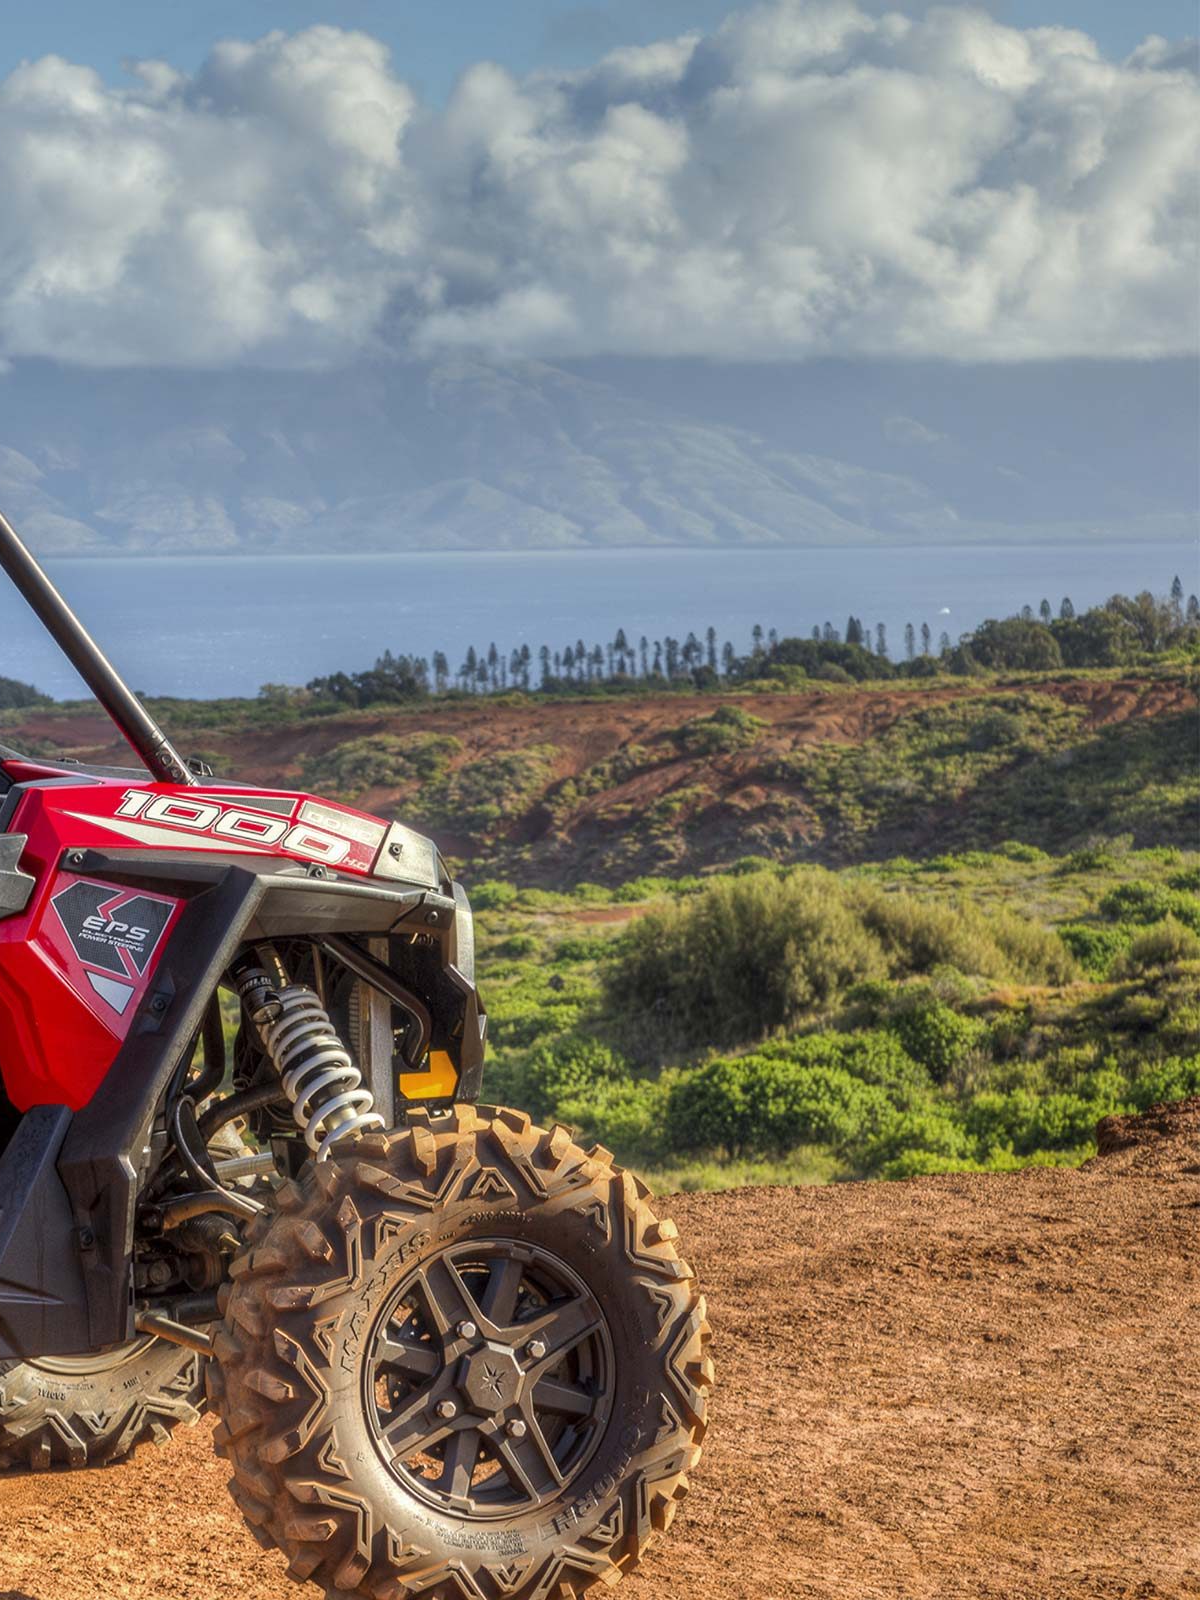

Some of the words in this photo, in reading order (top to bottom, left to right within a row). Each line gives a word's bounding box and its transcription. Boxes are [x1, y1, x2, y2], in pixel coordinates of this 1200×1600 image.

[116, 790, 350, 864] 1000
[81, 928, 145, 947] ELECTRONIC
[82, 916, 150, 941] EPS
[78, 932, 108, 944] POWER
[107, 940, 145, 953] STEERING
[340, 1228, 431, 1375] MAXXIS
